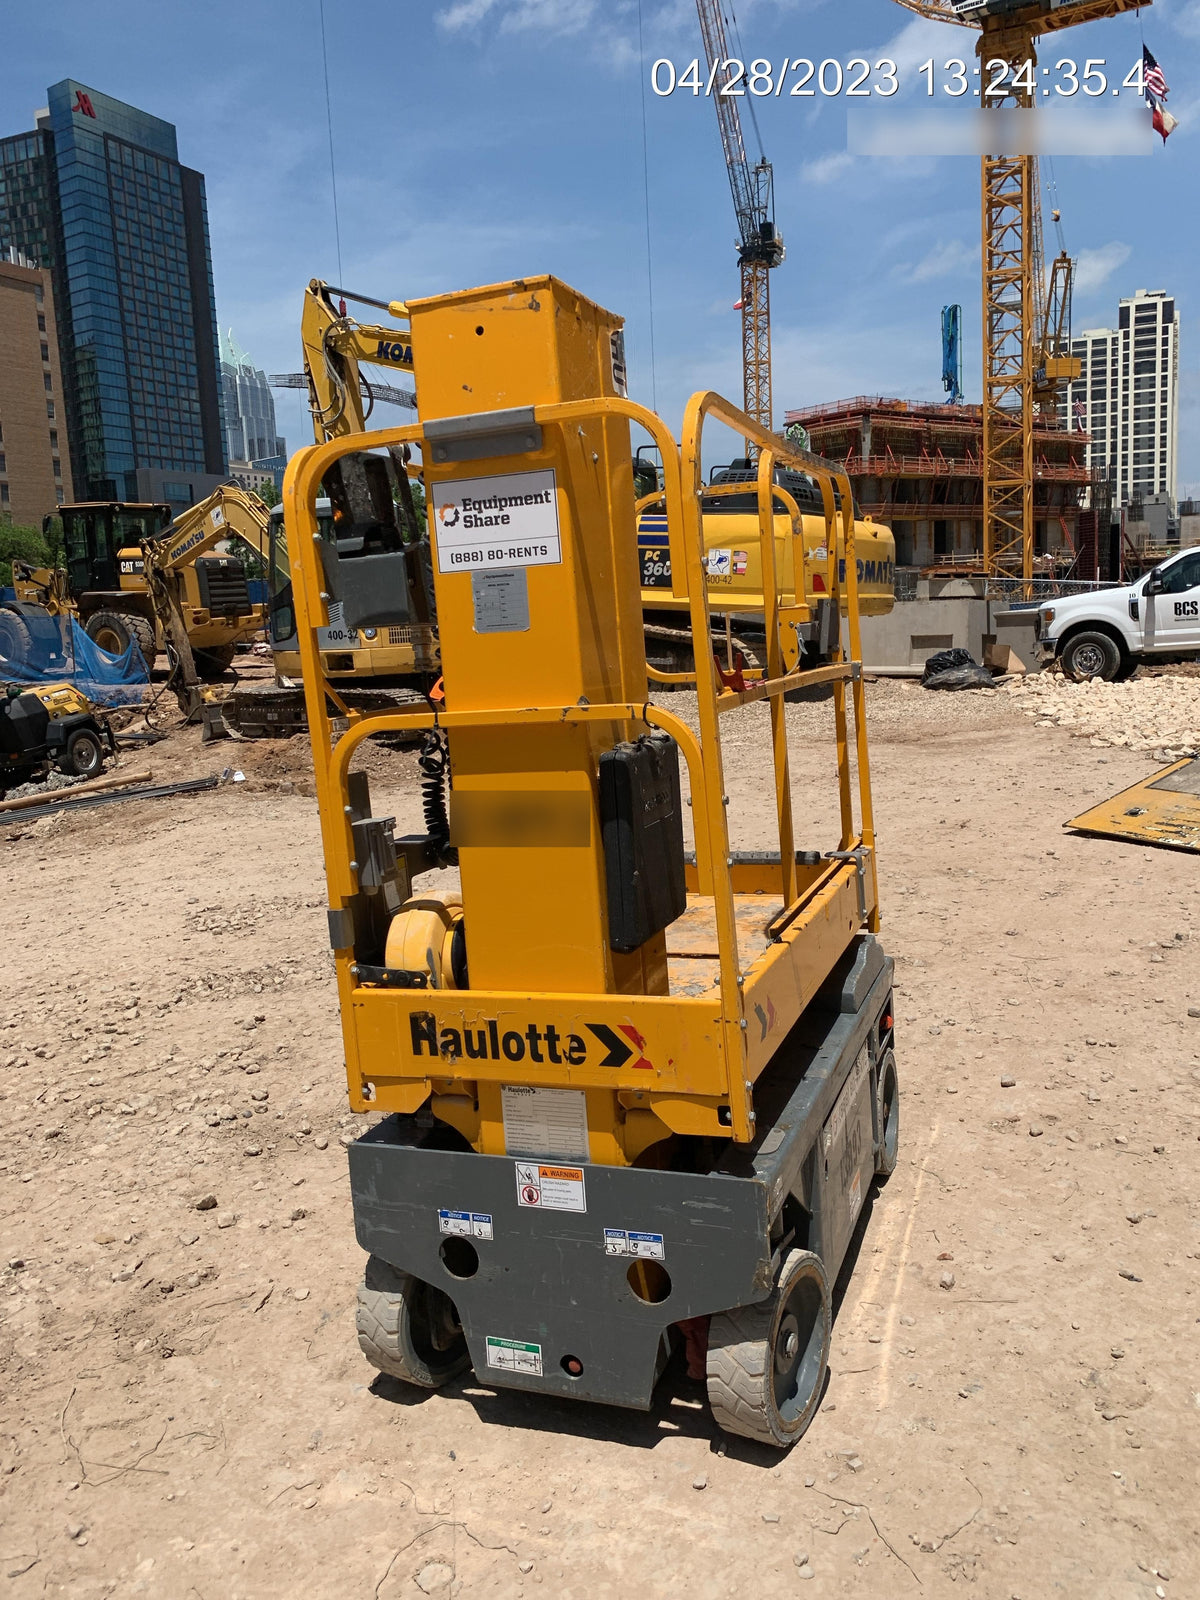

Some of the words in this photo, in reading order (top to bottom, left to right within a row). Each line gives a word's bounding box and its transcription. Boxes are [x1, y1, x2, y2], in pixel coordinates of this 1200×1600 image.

[461, 490, 552, 514] Equipment
[463, 513, 511, 529] Share
[170, 530, 205, 560] KOMATSU
[450, 550, 484, 564] (888)
[487, 545, 548, 561] 80-RENTS
[644, 550, 661, 561] PC
[121, 561, 134, 573] CAT
[644, 576, 656, 585] LC
[1174, 600, 1199, 616] BCS
[327, 629, 359, 640] 400-32
[409, 1011, 587, 1066] Haulotte
[550, 1169, 580, 1179] WARNING
